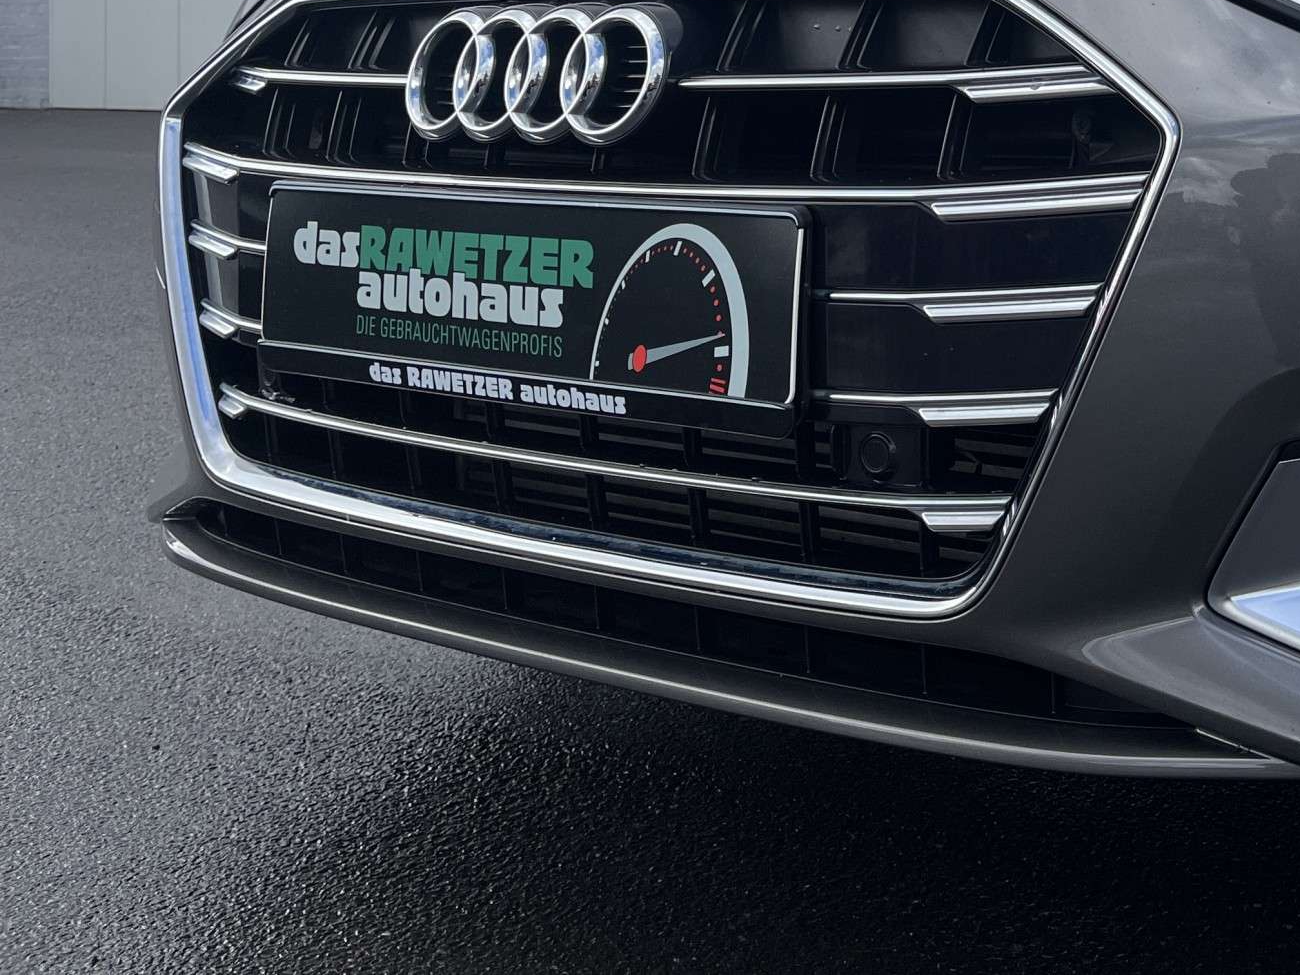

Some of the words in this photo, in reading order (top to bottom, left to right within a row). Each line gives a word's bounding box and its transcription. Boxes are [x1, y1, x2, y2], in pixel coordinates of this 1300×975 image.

[356, 268, 563, 328] autohaus
[356, 314, 376, 336] DIE
[380, 317, 563, 358] GEBRAUCHTWAGENPROFIS
[369, 362, 402, 385] das
[406, 366, 514, 400] RAWETZER
[520, 384, 627, 414] autohaus
